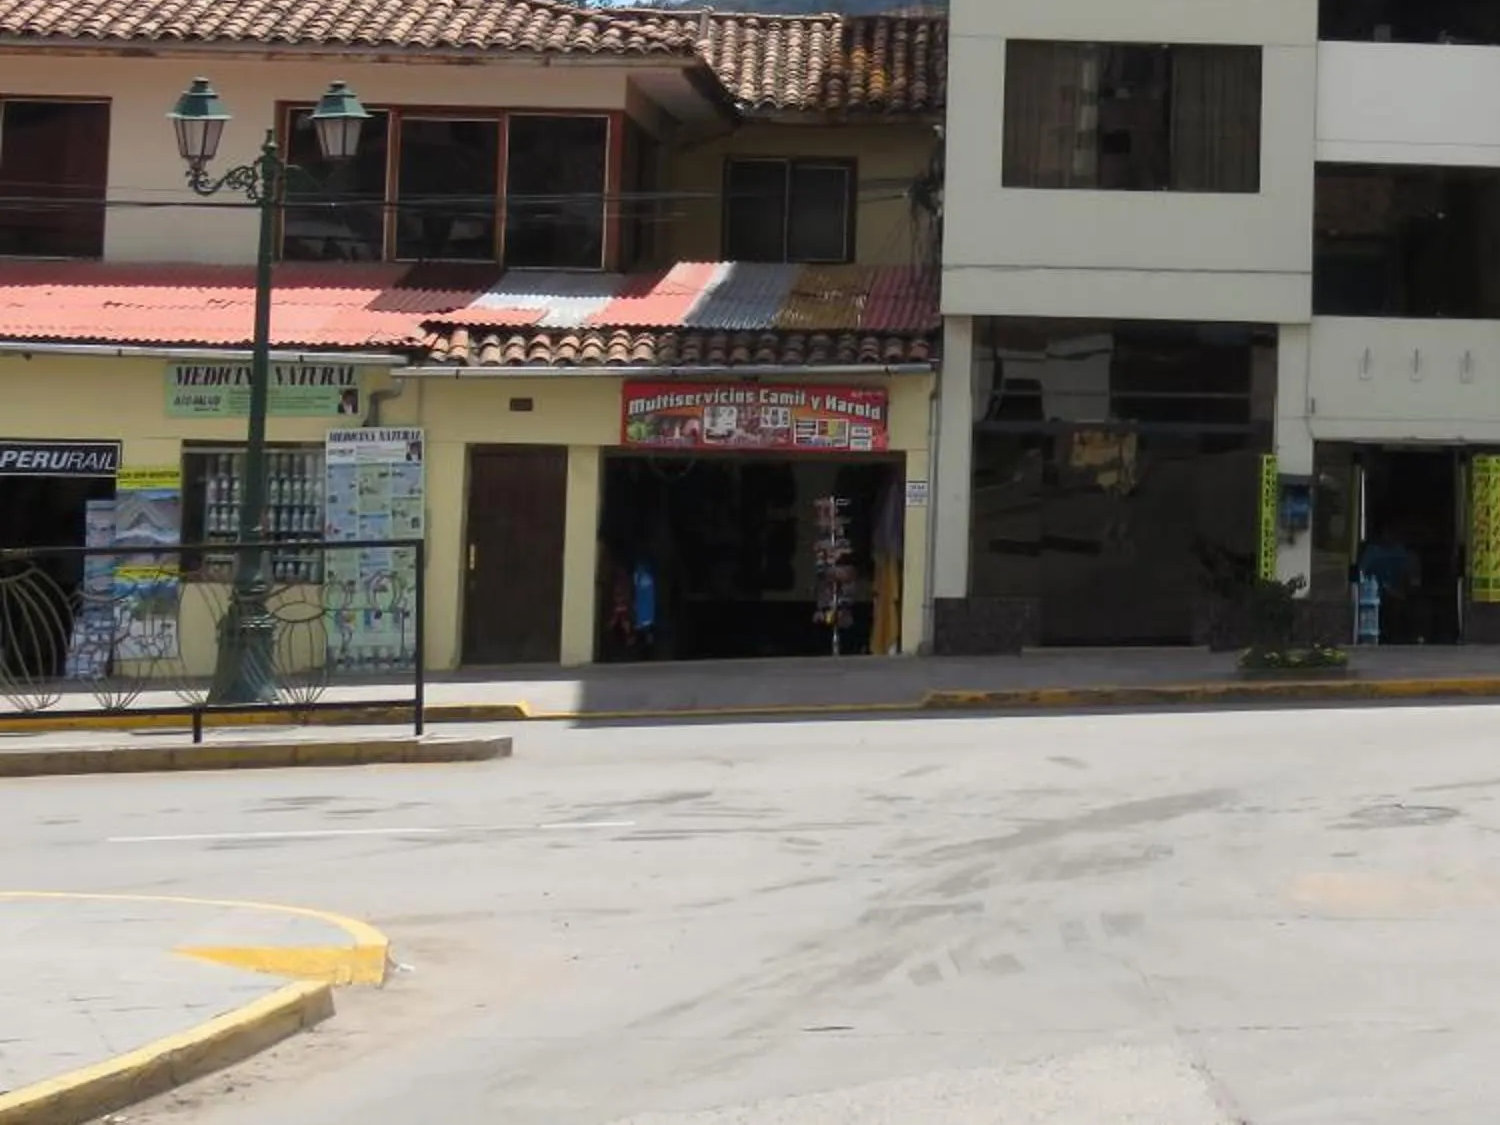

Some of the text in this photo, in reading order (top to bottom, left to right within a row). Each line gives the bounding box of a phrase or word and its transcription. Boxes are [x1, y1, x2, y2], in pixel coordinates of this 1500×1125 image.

[175, 365, 357, 386] MEDICIN NATURAL
[628, 388, 754, 416] Multiservicios
[0, 450, 117, 471] PERURAIL
